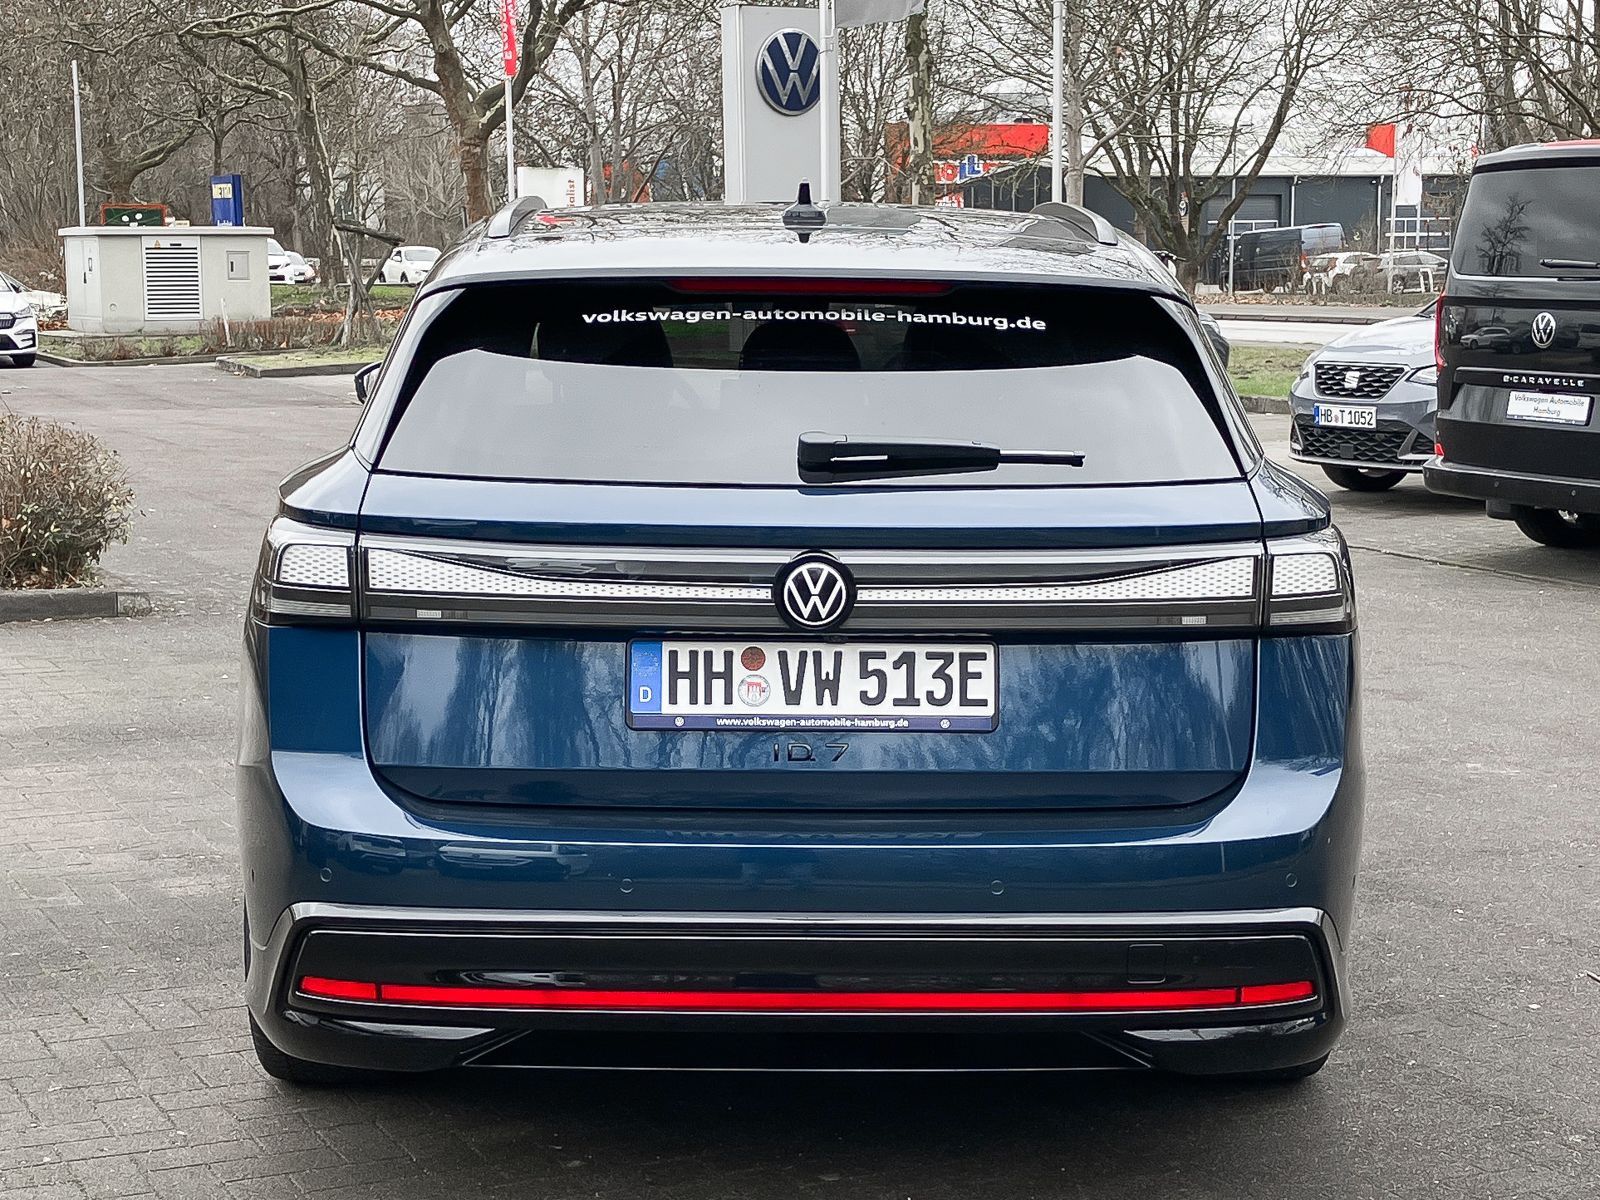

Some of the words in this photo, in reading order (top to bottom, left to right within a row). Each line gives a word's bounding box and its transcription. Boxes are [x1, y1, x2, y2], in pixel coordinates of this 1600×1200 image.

[582, 309, 1047, 331] volkswagen-automobile-hamburg.de
[1514, 394, 1548, 405] Volkswagen
[1549, 397, 1585, 407] Automobile
[1320, 408, 1333, 423] HB
[1339, 409, 1345, 424] T
[1347, 410, 1373, 426] 1052
[1533, 406, 1560, 417] Hamburg
[668, 650, 734, 705] HH
[777, 650, 843, 706] VW
[858, 651, 989, 707] 513E
[639, 687, 652, 702] D
[716, 717, 909, 729] www.volkswagen-automobile-hamburg.de
